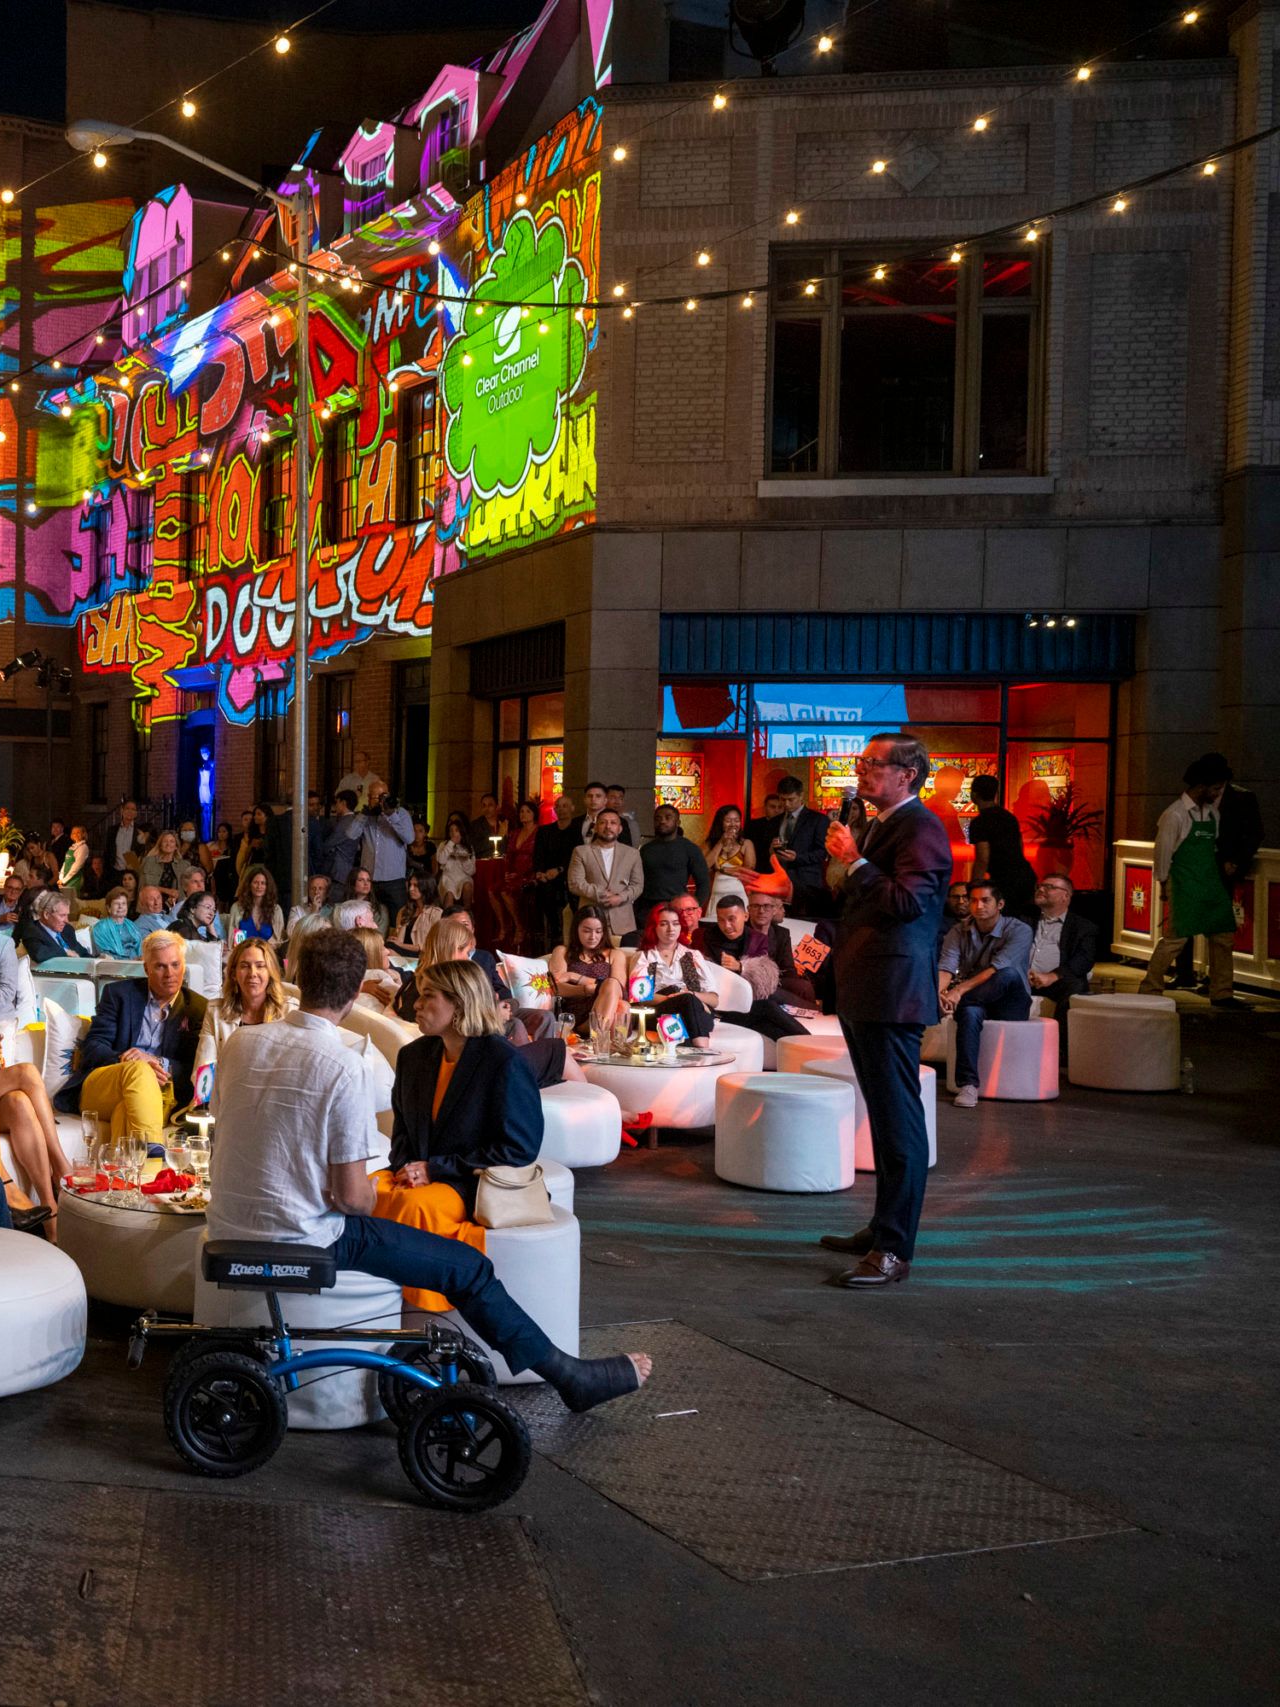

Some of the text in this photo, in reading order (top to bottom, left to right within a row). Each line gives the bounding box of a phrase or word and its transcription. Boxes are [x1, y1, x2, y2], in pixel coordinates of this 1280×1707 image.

[475, 346, 540, 397] Clear Channel
[488, 383, 525, 414] Outdoor
[801, 943, 822, 961] 1653
[638, 983, 645, 995] 3
[201, 1074, 208, 1093] 2
